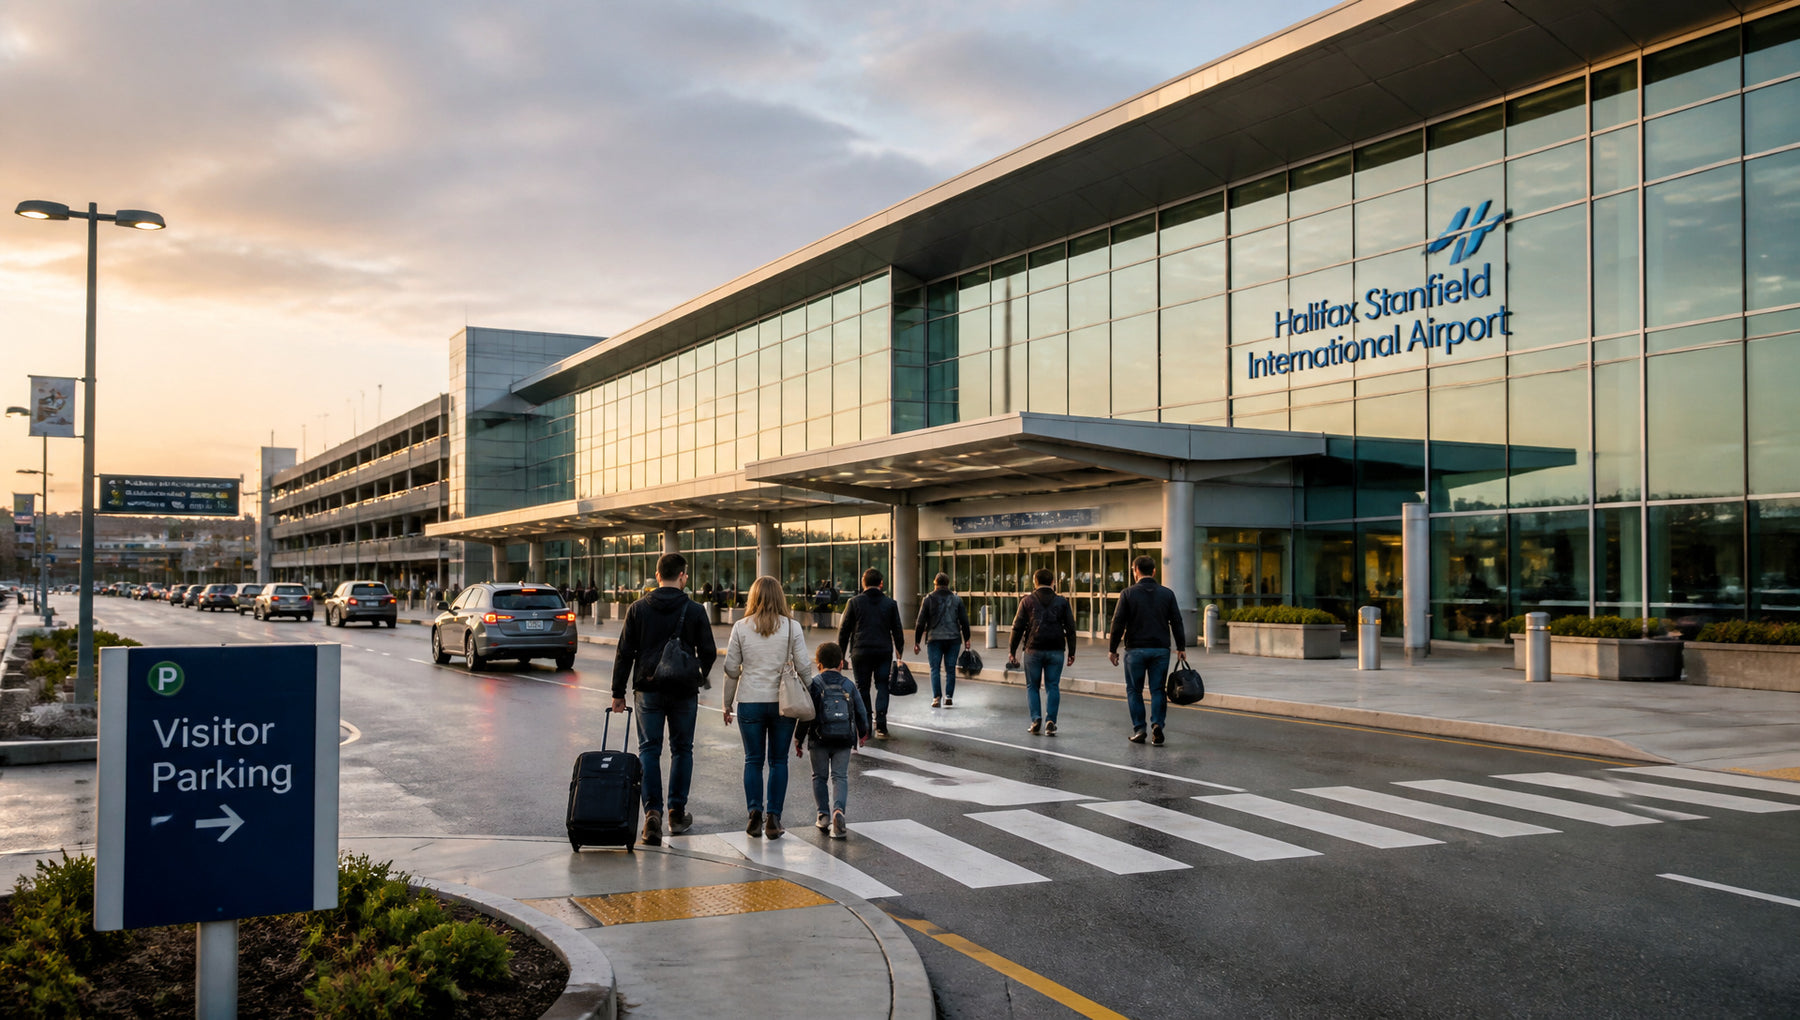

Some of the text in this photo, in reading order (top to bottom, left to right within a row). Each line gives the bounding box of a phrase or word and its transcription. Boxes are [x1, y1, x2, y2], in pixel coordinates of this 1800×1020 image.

[1274, 263, 1491, 338] Halifax Stanfield
[1248, 305, 1513, 379] International Airport
[157, 666, 178, 691] P
[152, 715, 275, 749] Visitor
[152, 758, 293, 794] Parking
